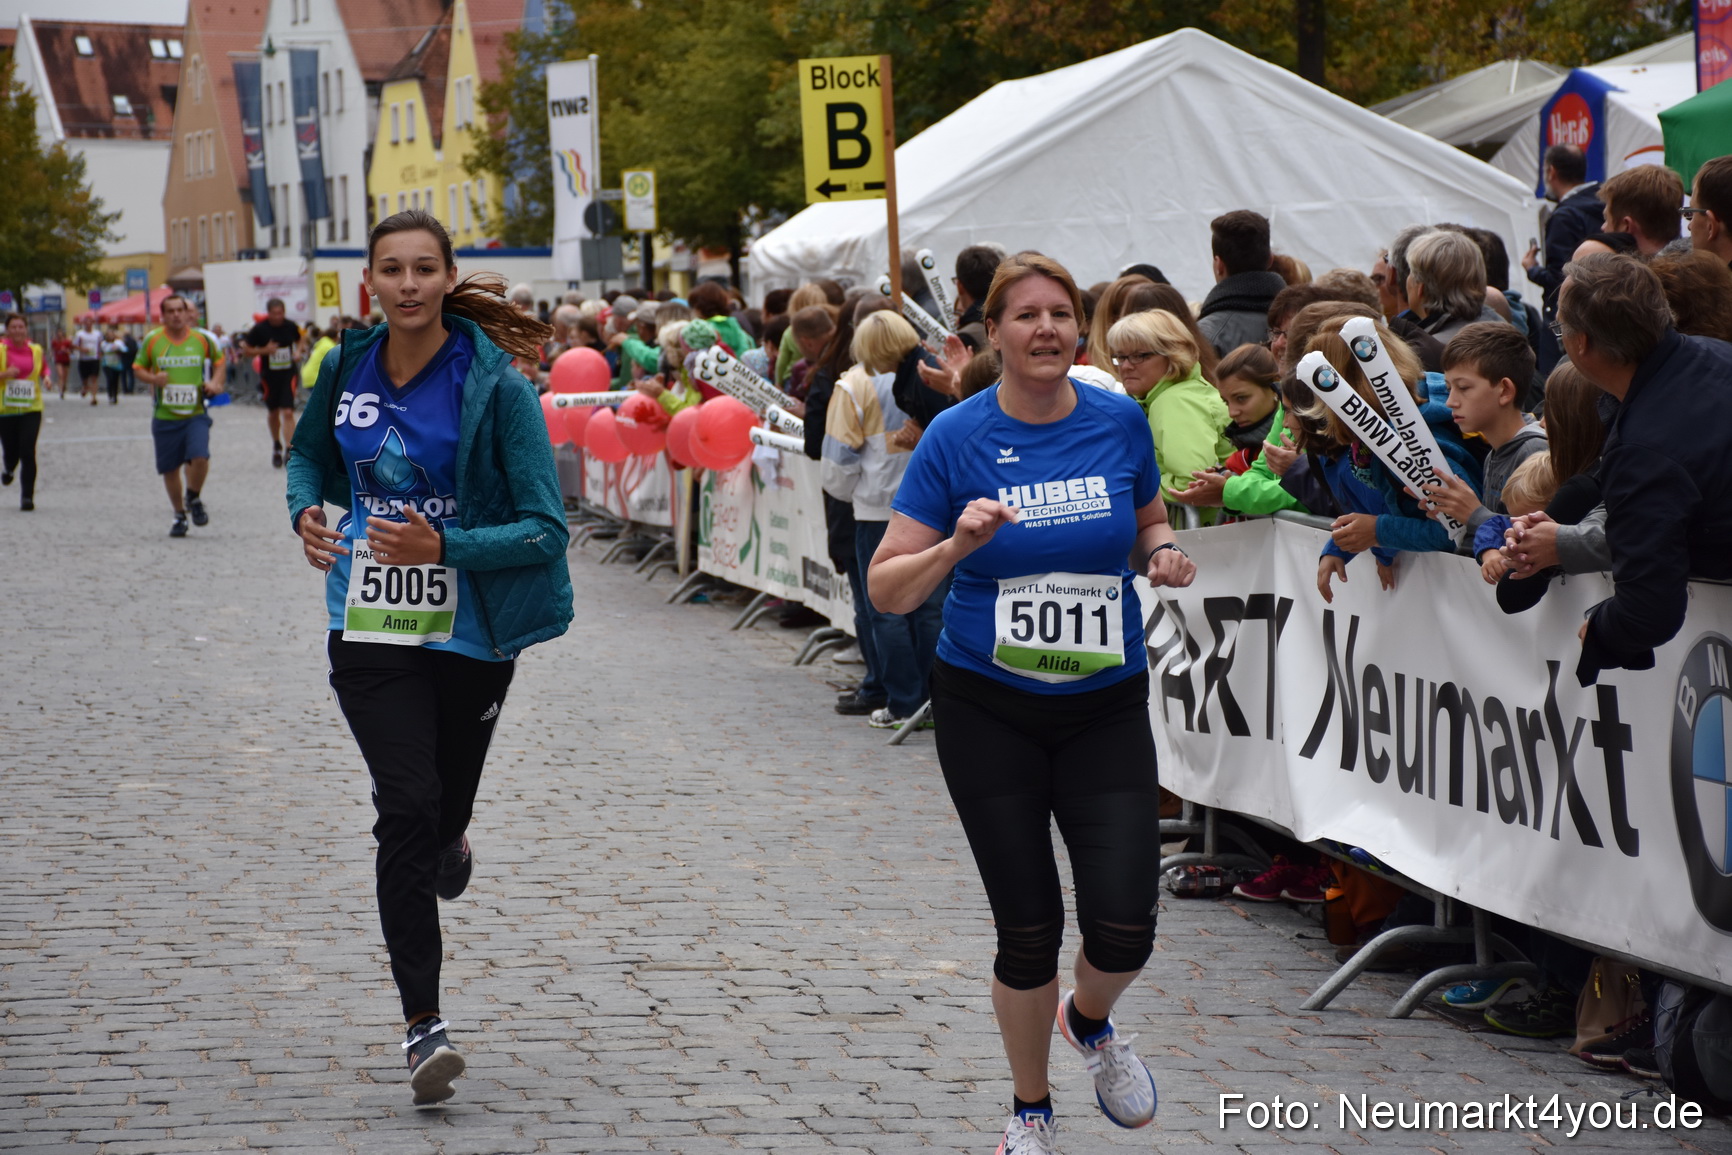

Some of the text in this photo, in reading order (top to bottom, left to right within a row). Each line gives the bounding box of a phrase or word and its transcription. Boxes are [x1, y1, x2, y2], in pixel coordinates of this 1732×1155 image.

[811, 63, 880, 90] Block
[826, 102, 872, 170] B
[320, 282, 334, 300] D
[902, 302, 948, 344] mw-laufsp
[599, 394, 628, 405] Laufs
[1340, 393, 1395, 447] BMW
[996, 456, 1020, 464] erima
[998, 475, 1110, 508] HUBER
[1024, 499, 1106, 518] TECHNOLOGY
[1024, 511, 1112, 529] WASTE WATER Solutions
[360, 566, 448, 607] 5005
[1001, 583, 1102, 598] PARTL Neumarkt
[382, 614, 418, 631] Anna
[1010, 600, 1108, 647] 5011
[1036, 655, 1081, 673] Alida
[1299, 608, 1640, 858] Neumarkt
